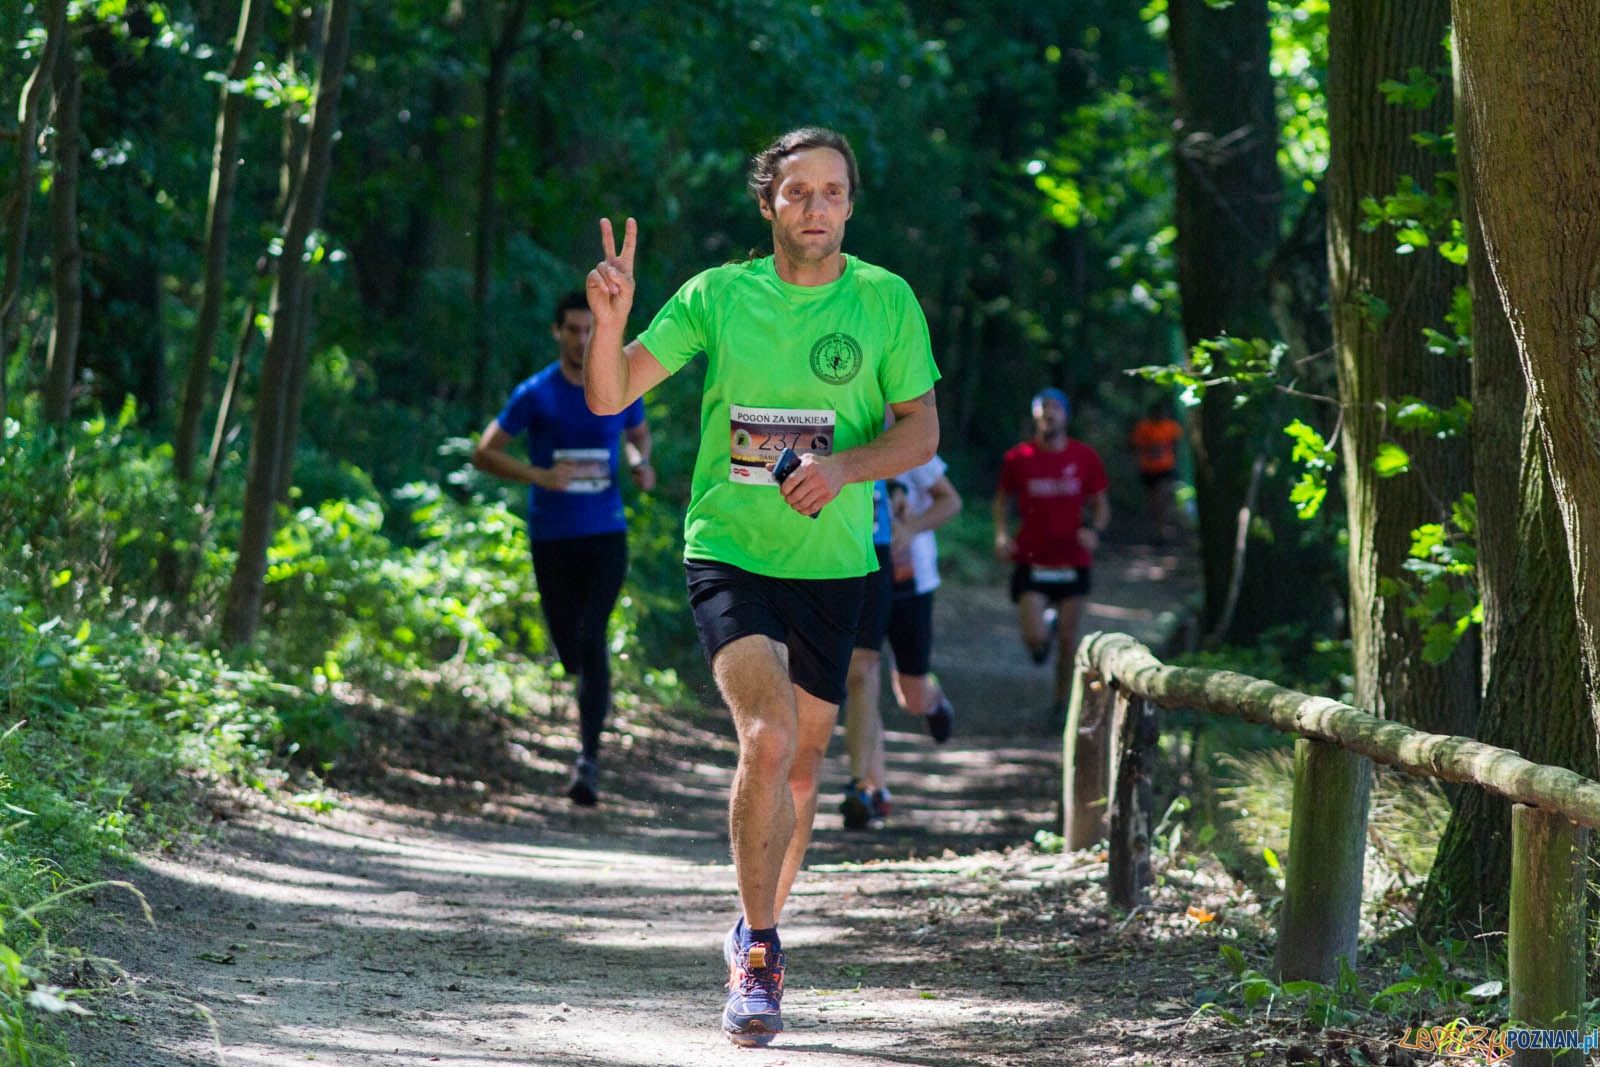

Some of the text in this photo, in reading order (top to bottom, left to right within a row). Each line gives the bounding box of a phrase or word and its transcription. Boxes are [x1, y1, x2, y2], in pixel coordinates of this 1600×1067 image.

[737, 412, 828, 424] POGOŃ ZA WILKIEM
[758, 432, 801, 451] 237
